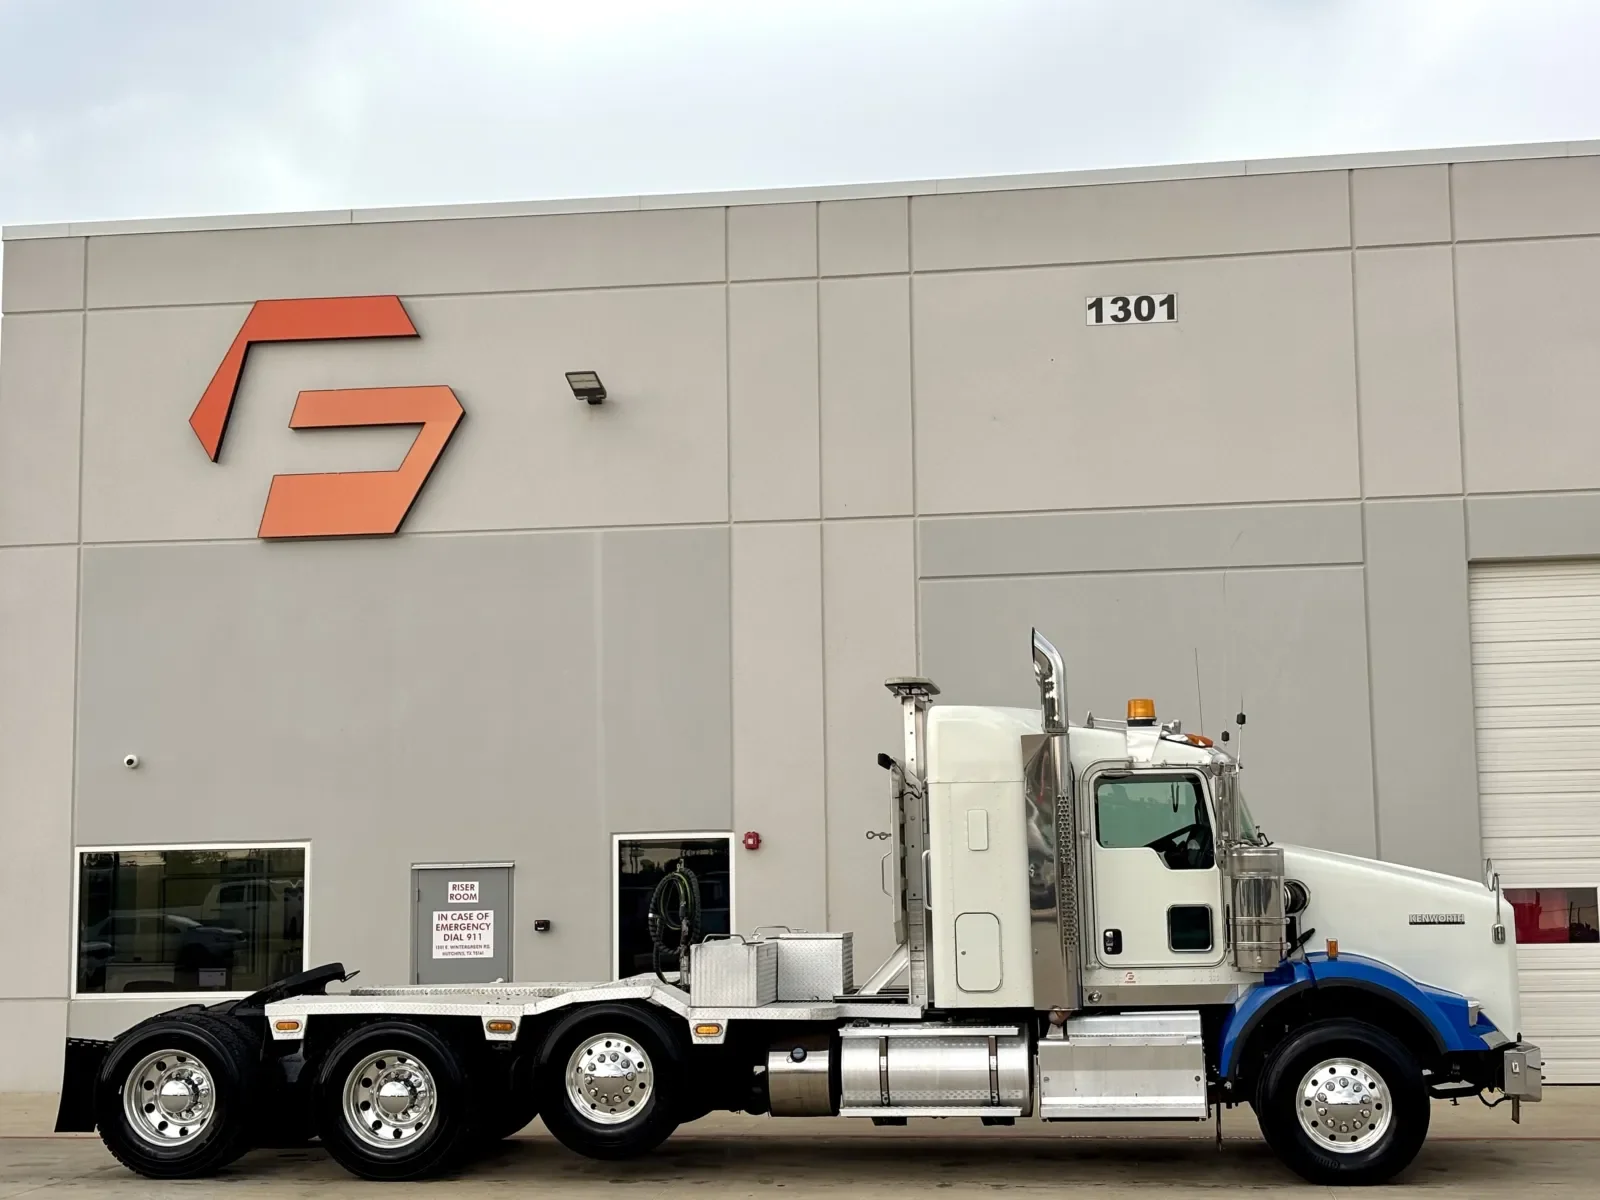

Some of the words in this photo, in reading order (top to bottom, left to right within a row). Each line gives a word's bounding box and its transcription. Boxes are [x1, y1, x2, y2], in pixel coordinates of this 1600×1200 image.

[1088, 294, 1175, 323] 1301
[449, 893, 478, 901] ROOM
[450, 913, 474, 921] CASE
[476, 912, 490, 921] OF
[1409, 914, 1464, 924] KENWORTH
[435, 923, 492, 931] EMERGENCY
[443, 933, 465, 942] DIAL
[466, 933, 482, 941] 911
